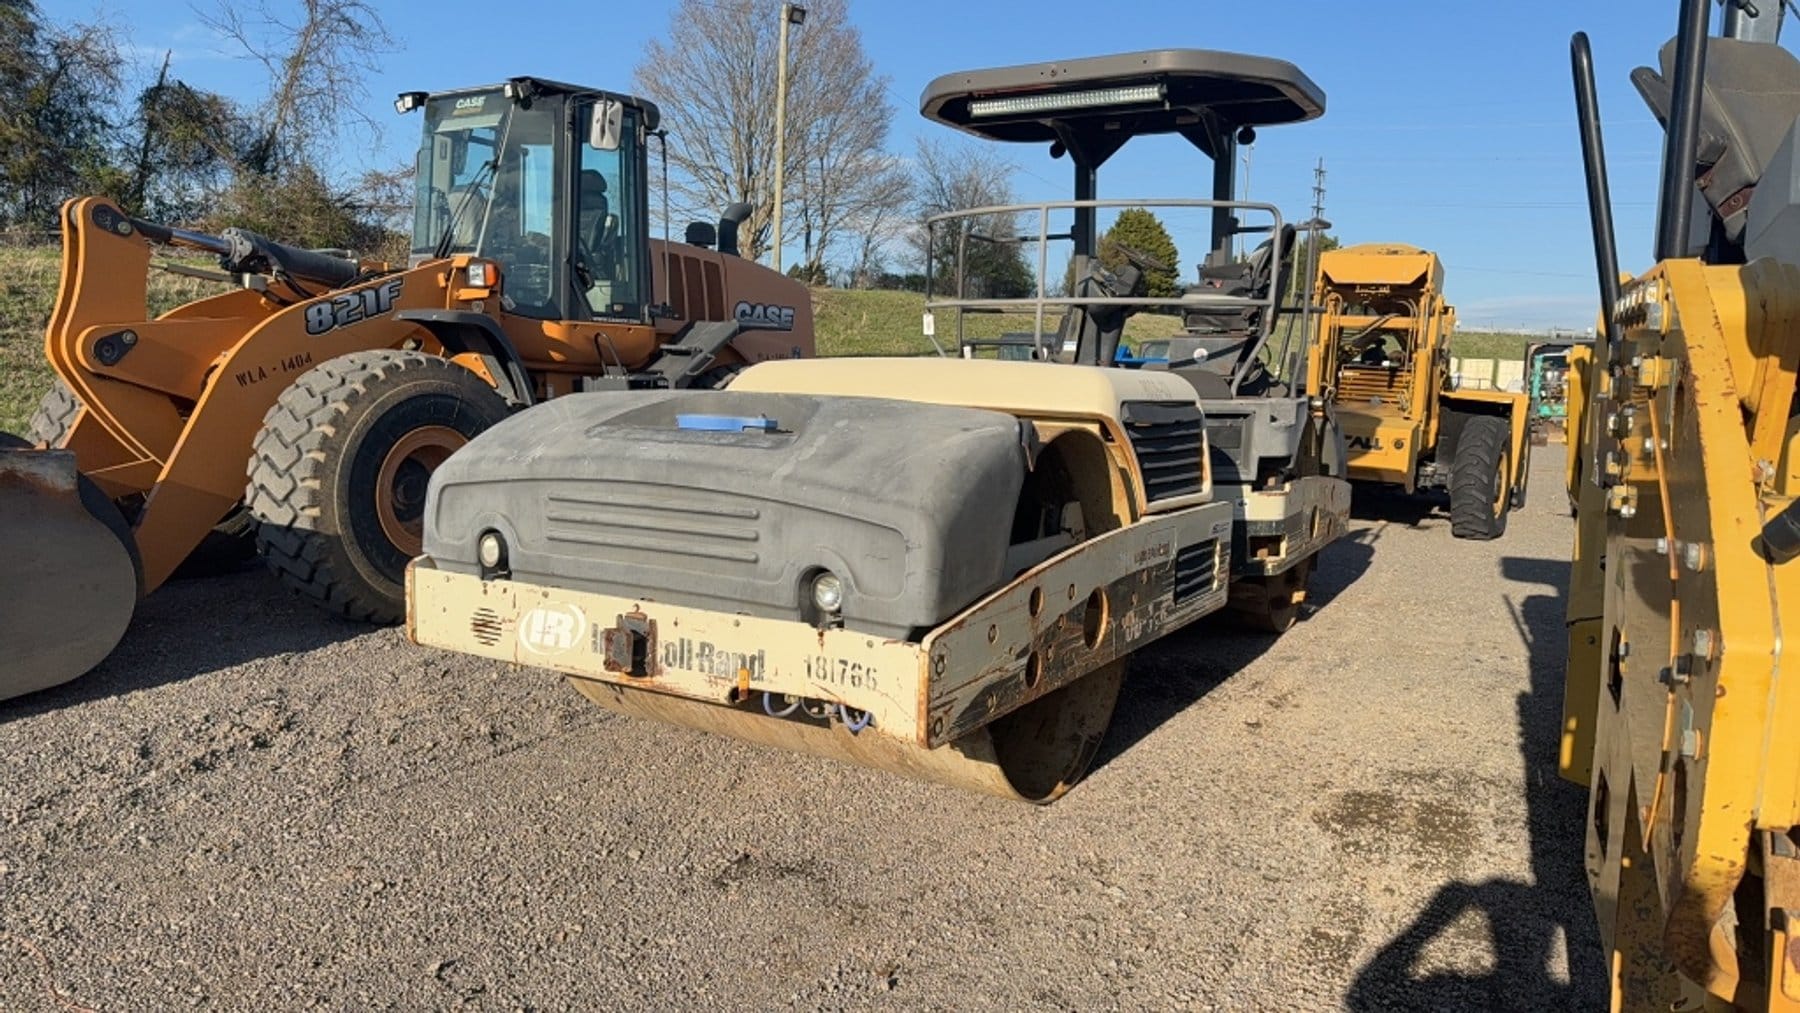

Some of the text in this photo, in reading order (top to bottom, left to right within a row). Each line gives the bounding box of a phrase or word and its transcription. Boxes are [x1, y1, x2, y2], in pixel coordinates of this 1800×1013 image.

[455, 95, 487, 109] CASE
[304, 279, 404, 336] 821F
[734, 301, 795, 326] CASE
[235, 364, 268, 387] WLA
[590, 622, 766, 682] Ioll-Rand
